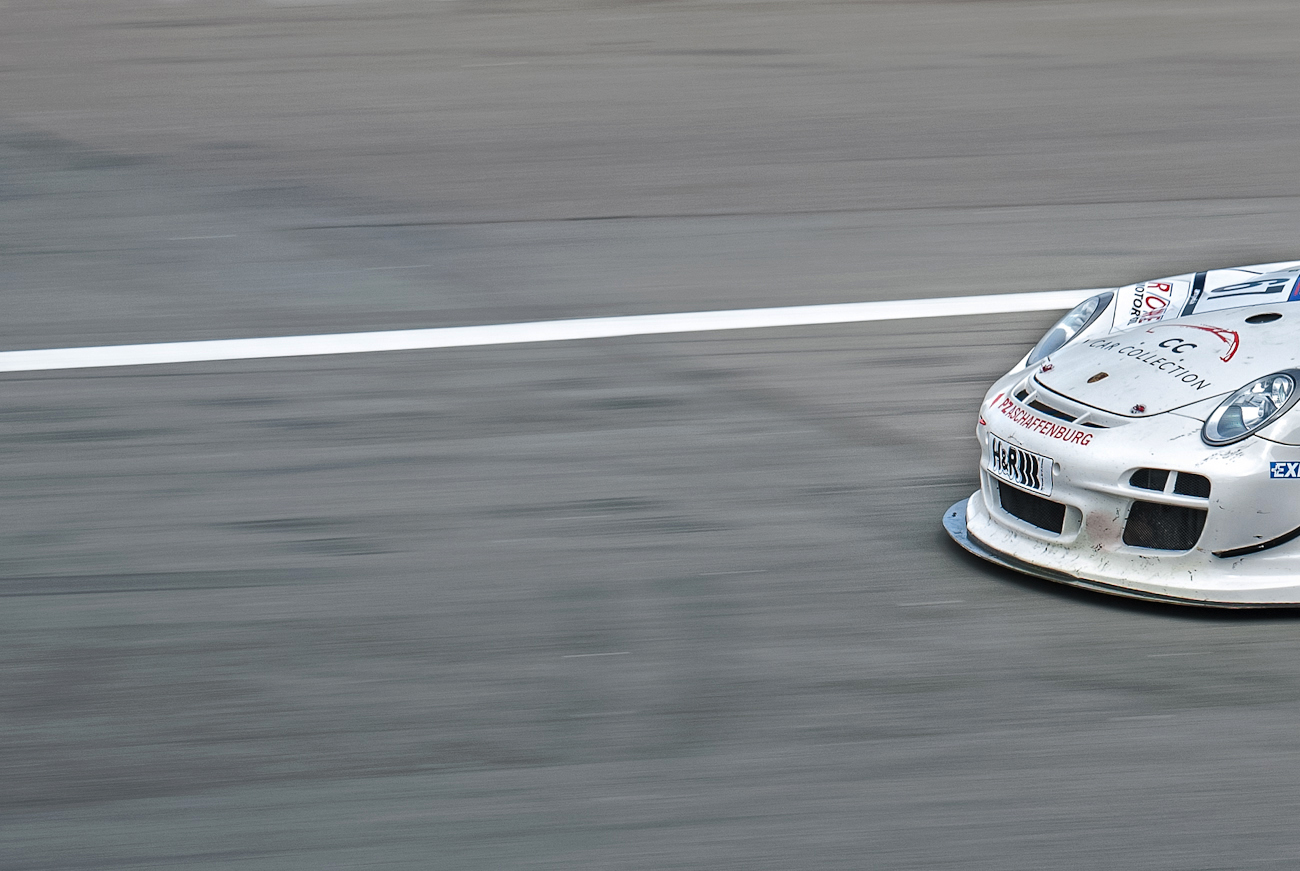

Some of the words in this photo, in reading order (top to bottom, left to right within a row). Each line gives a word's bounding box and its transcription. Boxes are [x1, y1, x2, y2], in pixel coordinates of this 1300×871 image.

[1158, 338, 1198, 354] CC
[1089, 339, 1121, 351] CAR
[1118, 345, 1212, 391] COLLECTION
